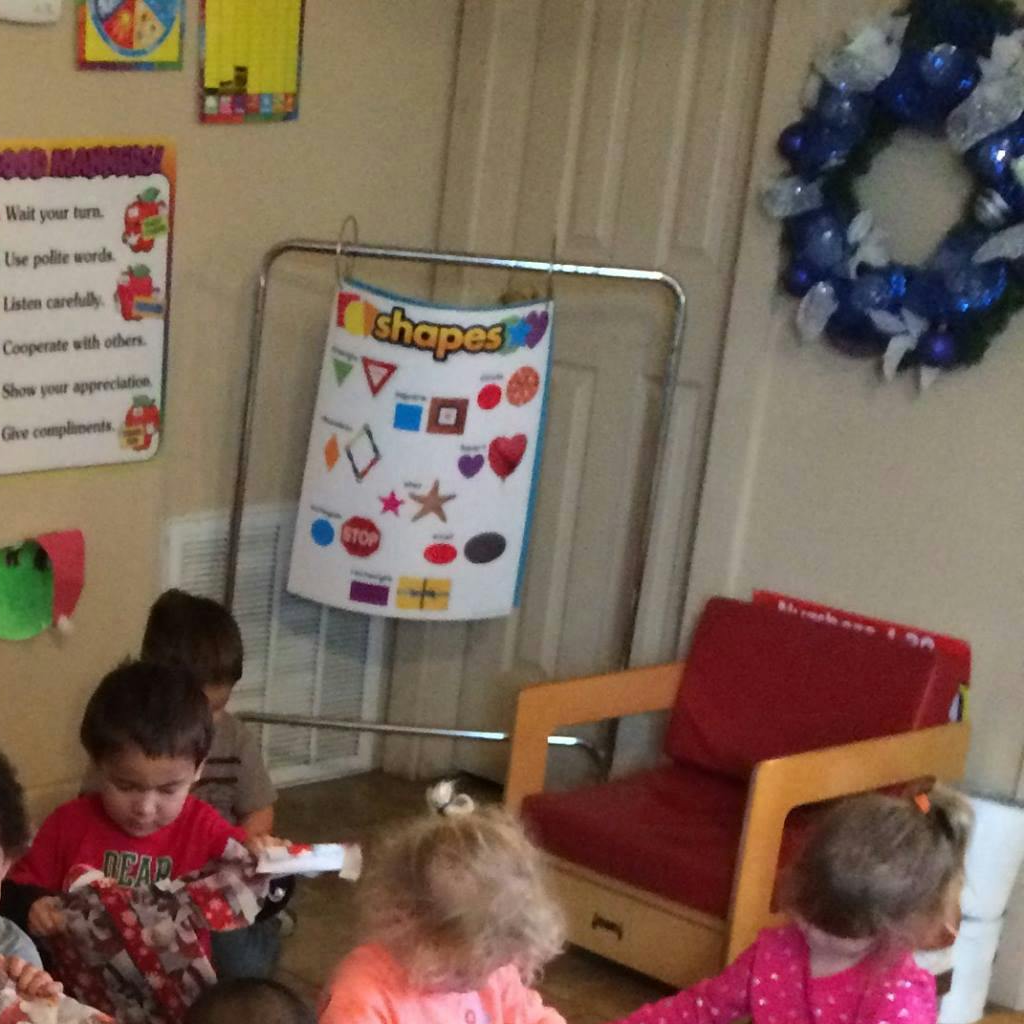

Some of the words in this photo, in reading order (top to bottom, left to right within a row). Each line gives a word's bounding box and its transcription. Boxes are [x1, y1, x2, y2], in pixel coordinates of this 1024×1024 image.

[6, 205, 35, 222] Wait
[40, 209, 68, 224] your
[73, 207, 103, 218] turn.
[5, 251, 29, 266] Use
[33, 249, 69, 269] polite
[3, 296, 41, 312] Listen
[372, 306, 505, 362] shapes
[3, 340, 68, 357] Cooperate
[73, 334, 100, 350] with
[2, 383, 35, 399] Show
[40, 384, 68, 398] your
[1, 425, 28, 442] Give
[342, 526, 377, 547] STOP
